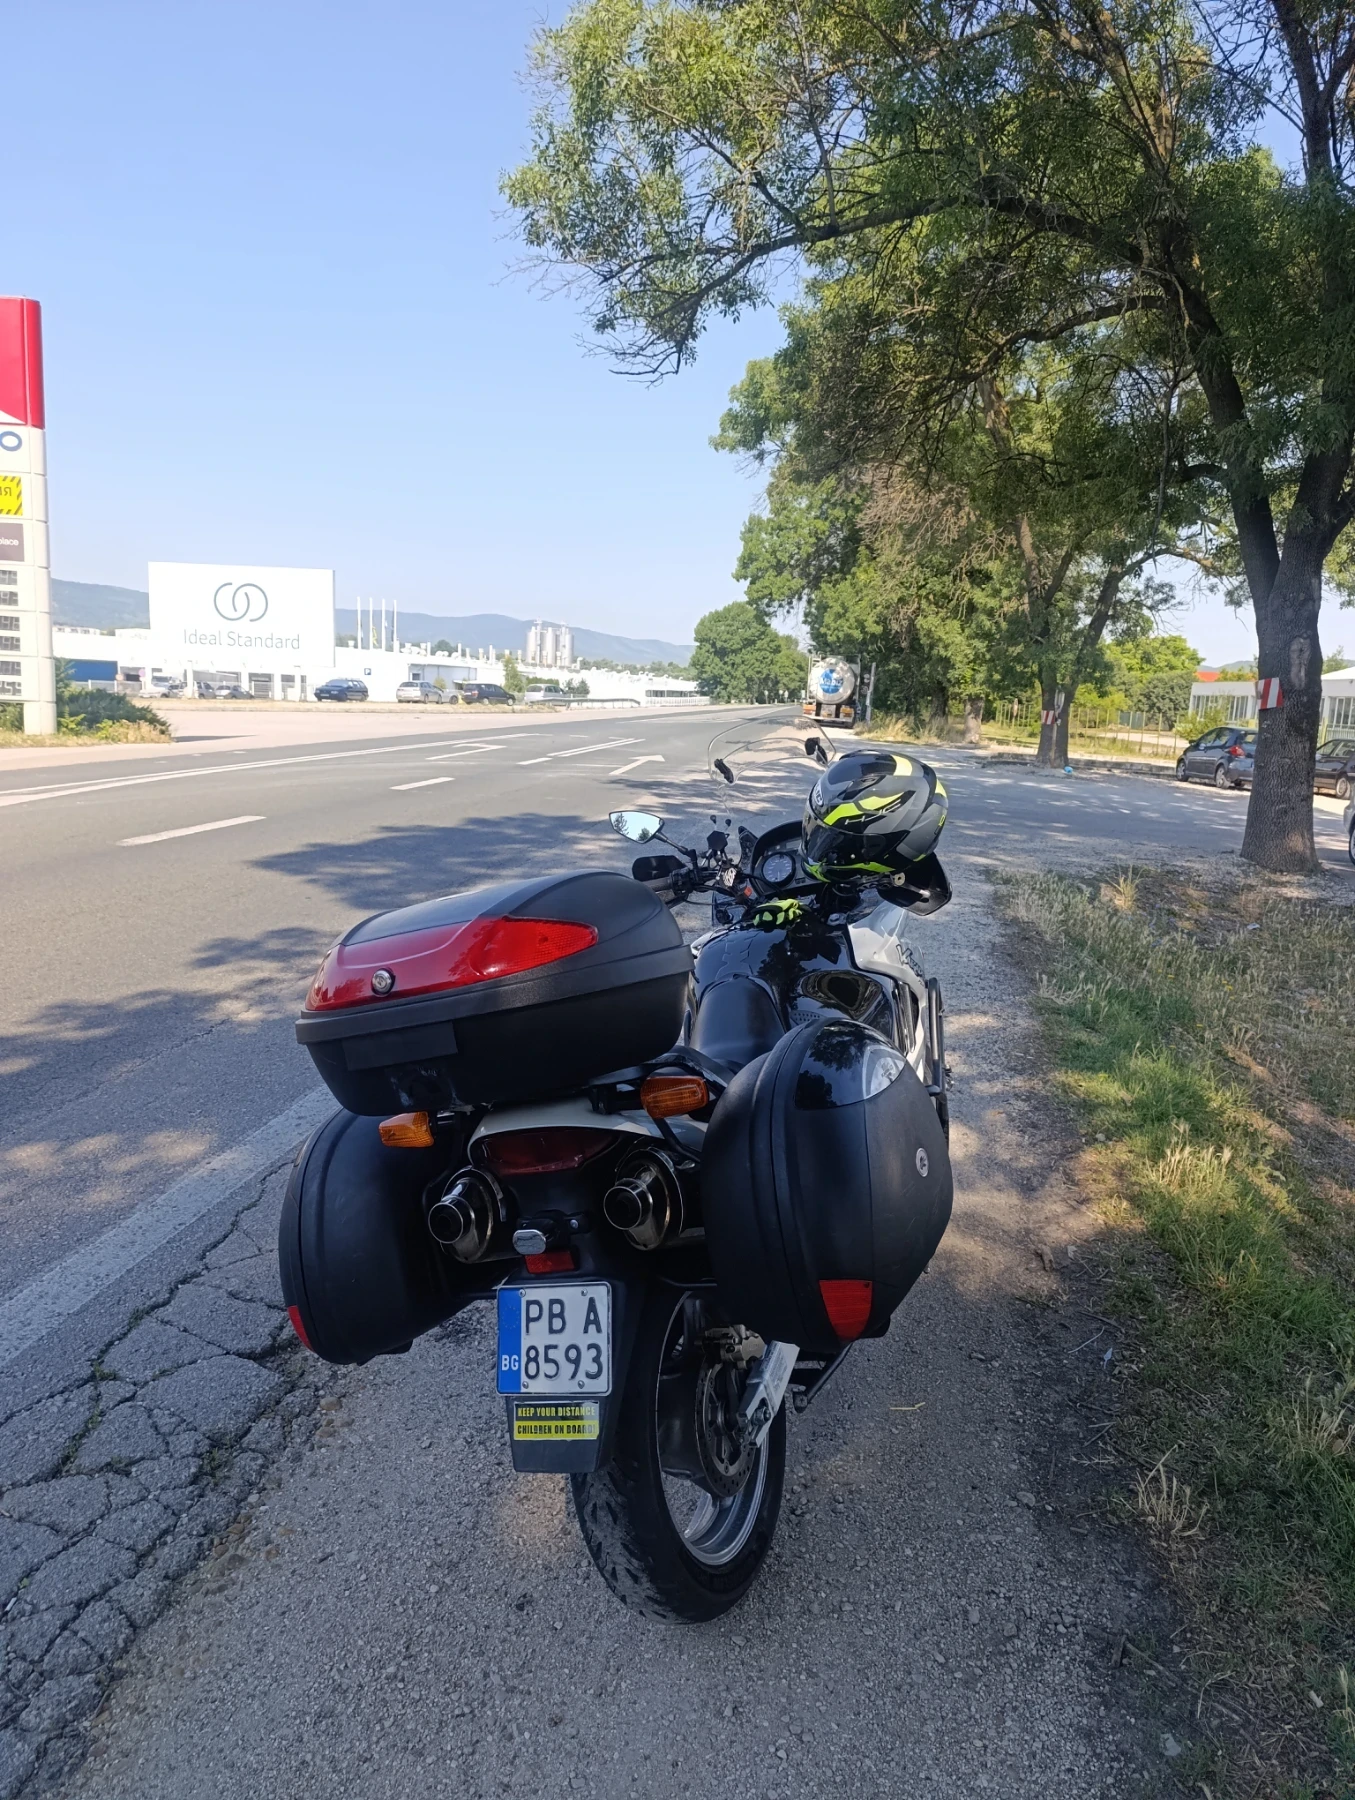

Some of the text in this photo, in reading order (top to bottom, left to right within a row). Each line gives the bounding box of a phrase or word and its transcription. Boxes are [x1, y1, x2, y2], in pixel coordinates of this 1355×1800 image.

[184, 628, 300, 650] Ideal Standard
[844, 798, 902, 825] HJC
[525, 1296, 603, 1335] PB A
[501, 1354, 519, 1371] BG
[524, 1342, 603, 1381] 8593
[517, 1406, 595, 1417] KEEP YOUR DISTANCE
[517, 1424, 552, 1435] CHILDREN
[554, 1424, 564, 1434] ON
